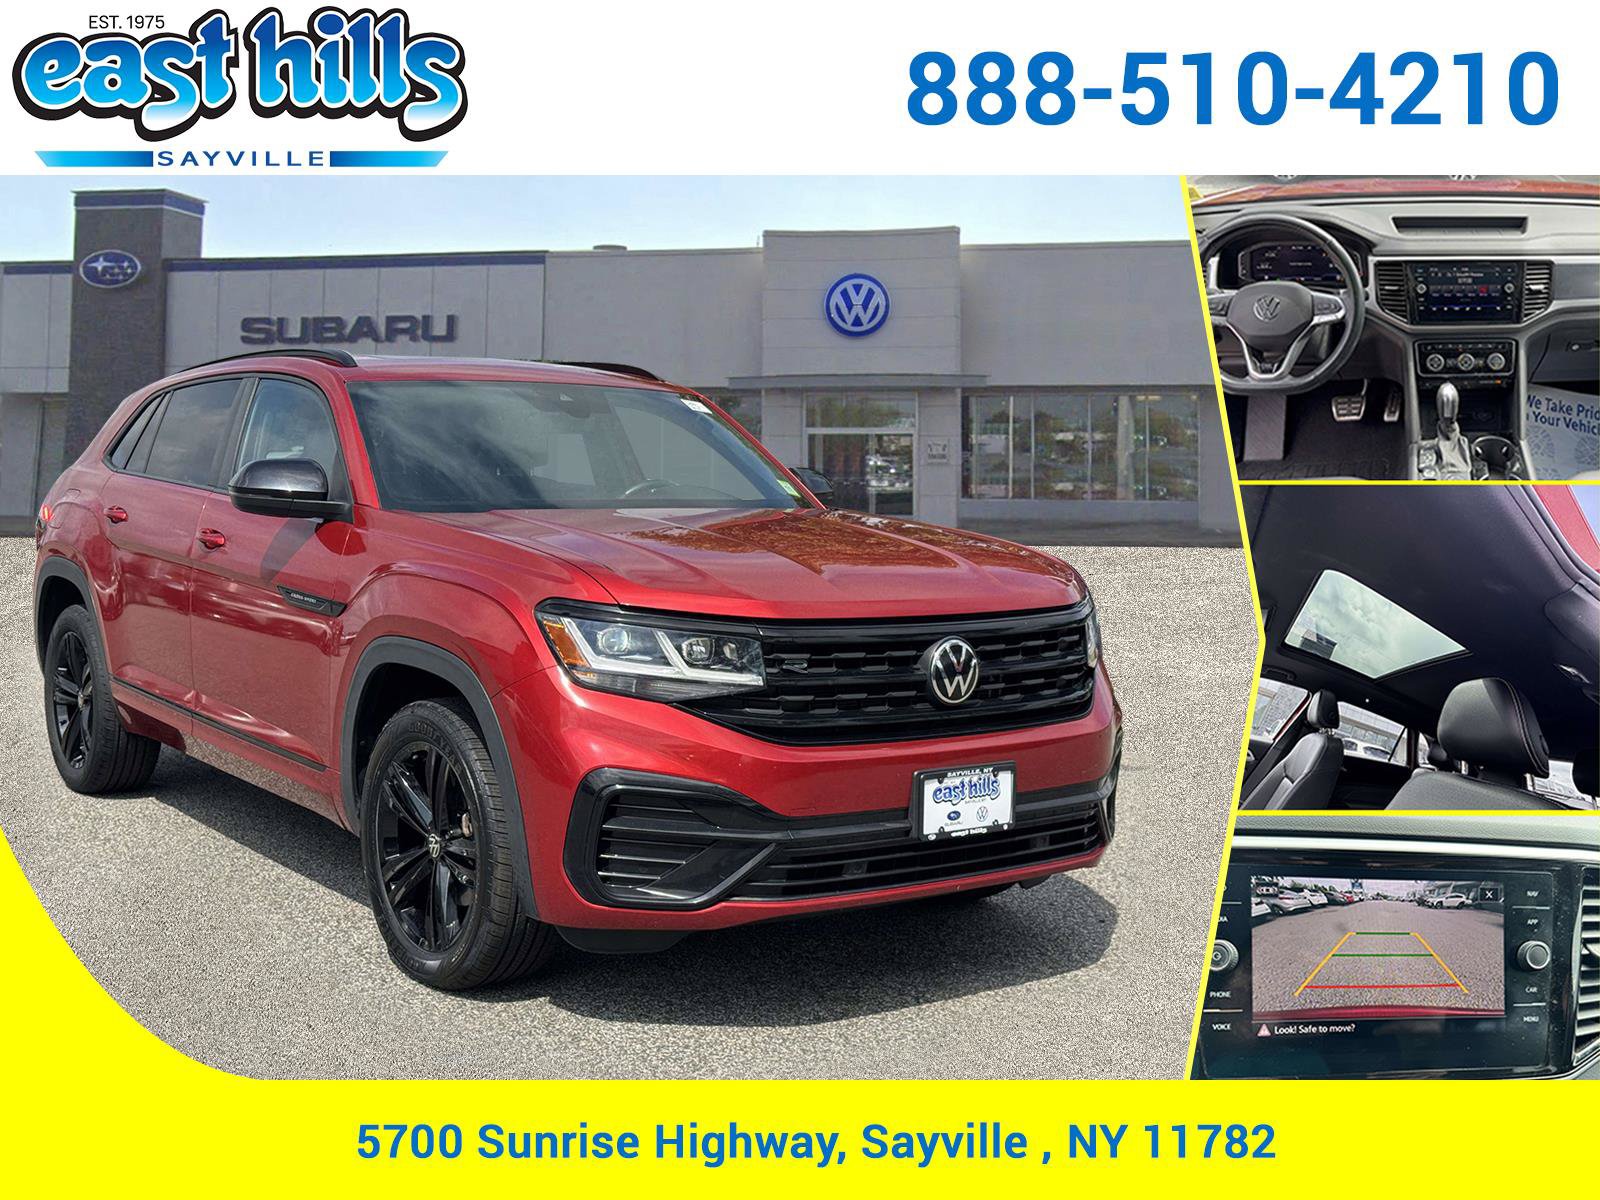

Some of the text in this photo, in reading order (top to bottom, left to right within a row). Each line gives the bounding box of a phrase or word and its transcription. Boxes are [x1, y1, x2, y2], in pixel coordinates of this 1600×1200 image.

[240, 314, 456, 345] SUBARU
[1545, 397, 1573, 416] Take
[1533, 411, 1560, 427] Your
[933, 775, 1001, 806] east hills
[1212, 1023, 1231, 1031] VOICE
[1523, 1015, 1540, 1023] MENU
[1274, 1023, 1356, 1035] Look! Safe to move?
